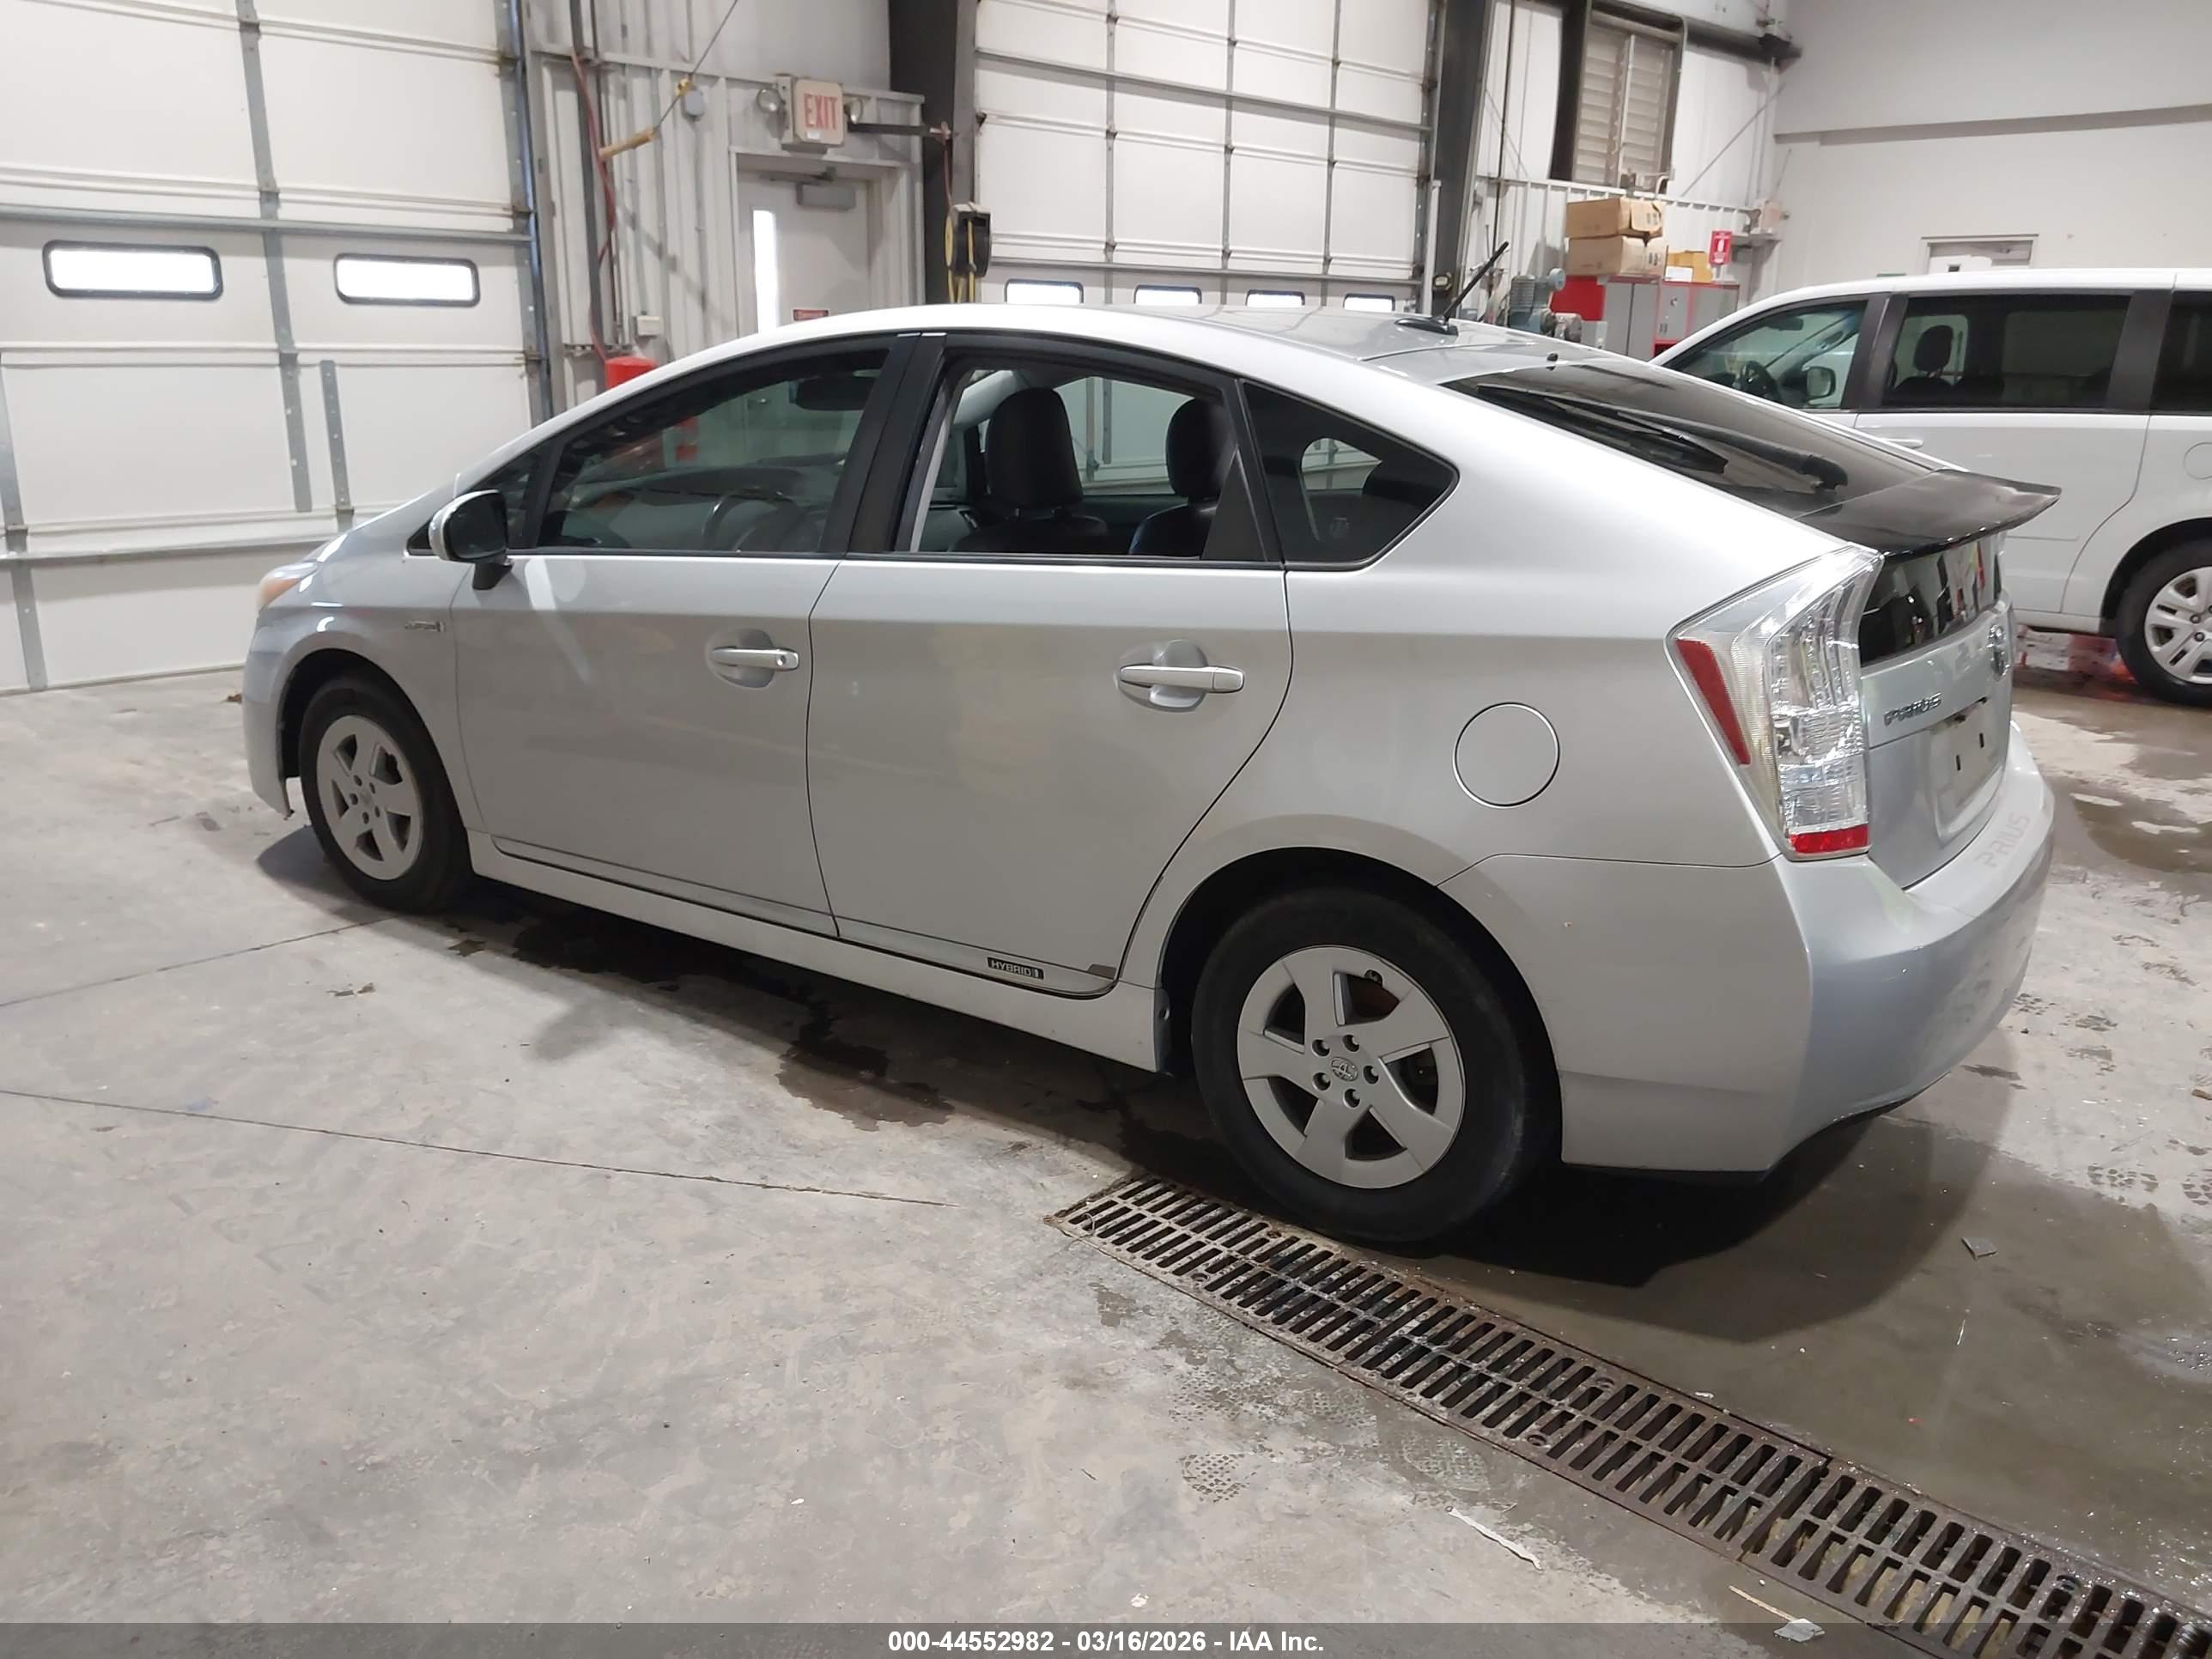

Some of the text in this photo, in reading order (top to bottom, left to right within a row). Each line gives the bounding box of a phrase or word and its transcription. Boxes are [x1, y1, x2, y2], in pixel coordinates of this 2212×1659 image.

[804, 93, 838, 131] EXIT
[1884, 692, 1942, 726] PRIUS
[1975, 813, 2032, 868] PRIUS
[991, 959, 1031, 976] HYBRID
